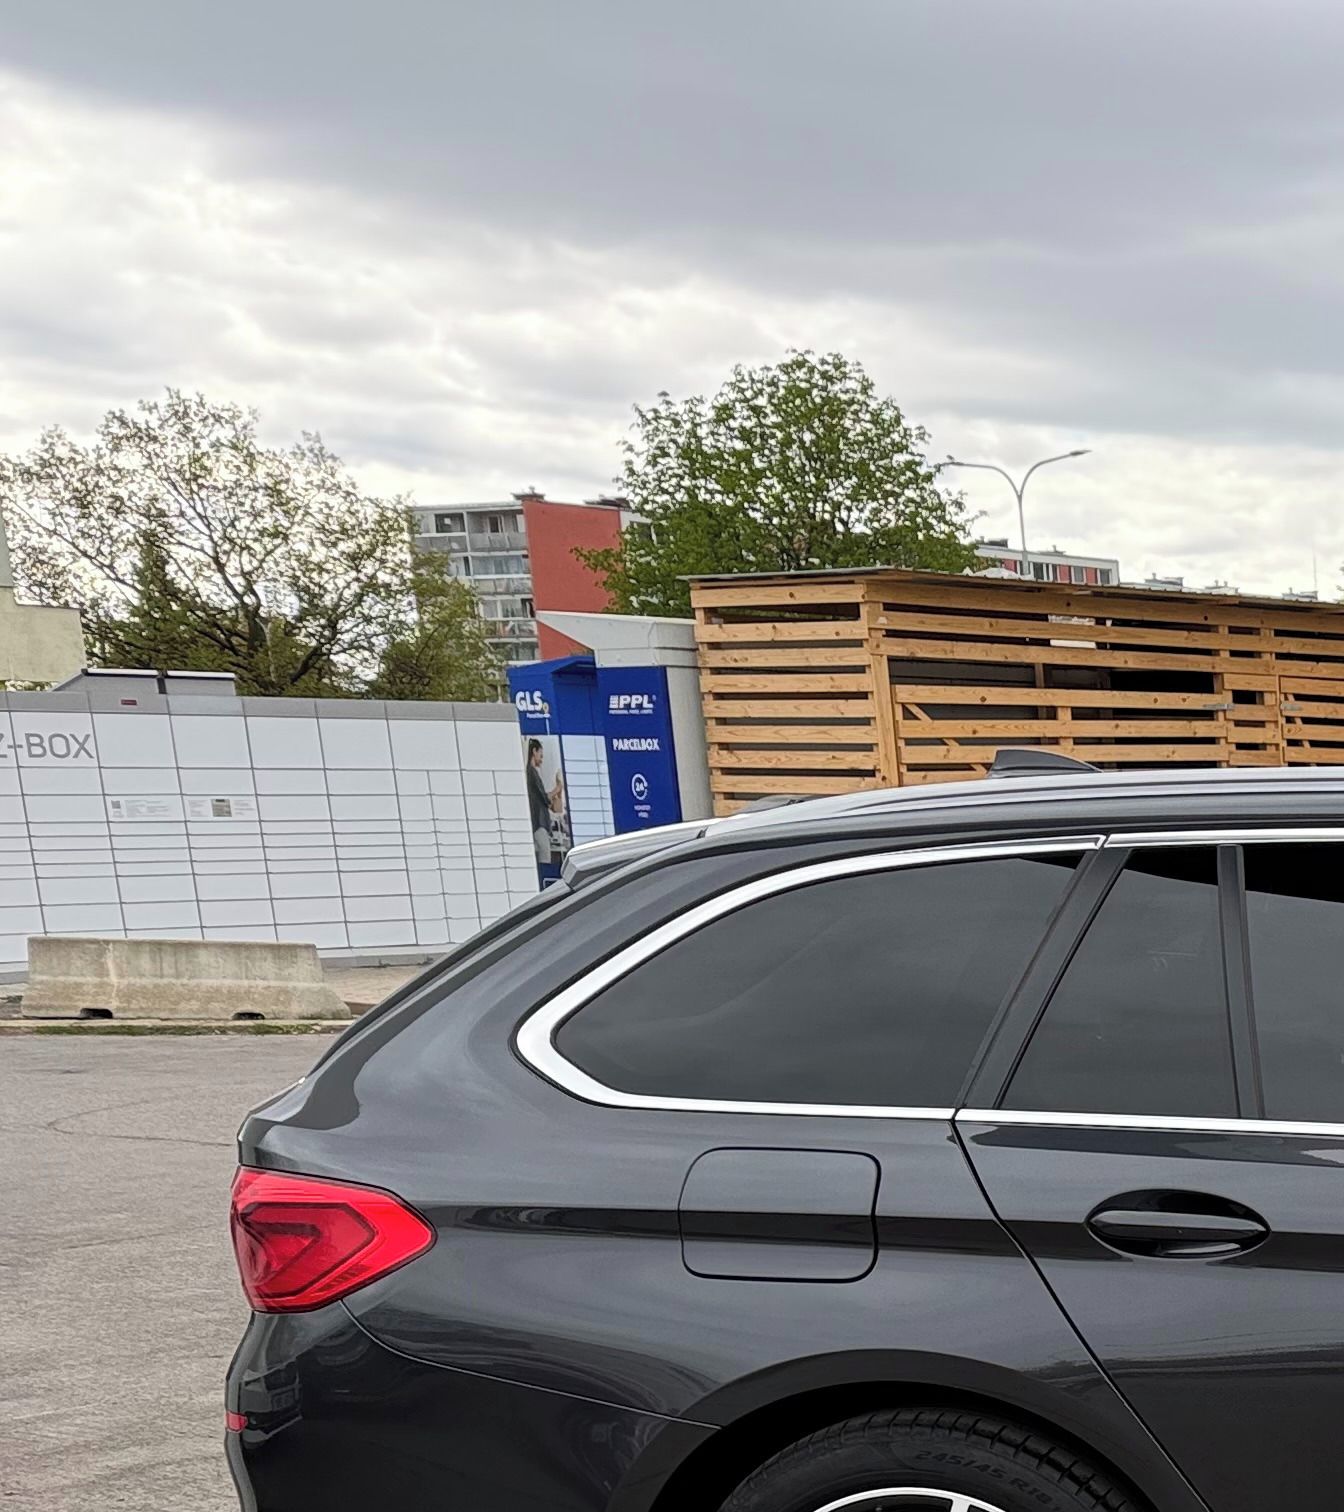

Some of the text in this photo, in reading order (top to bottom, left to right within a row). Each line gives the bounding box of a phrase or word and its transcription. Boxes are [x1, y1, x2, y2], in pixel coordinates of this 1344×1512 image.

[515, 690, 543, 711] GLS
[619, 694, 654, 709] PPL
[612, 738, 661, 751] PARCELBOX
